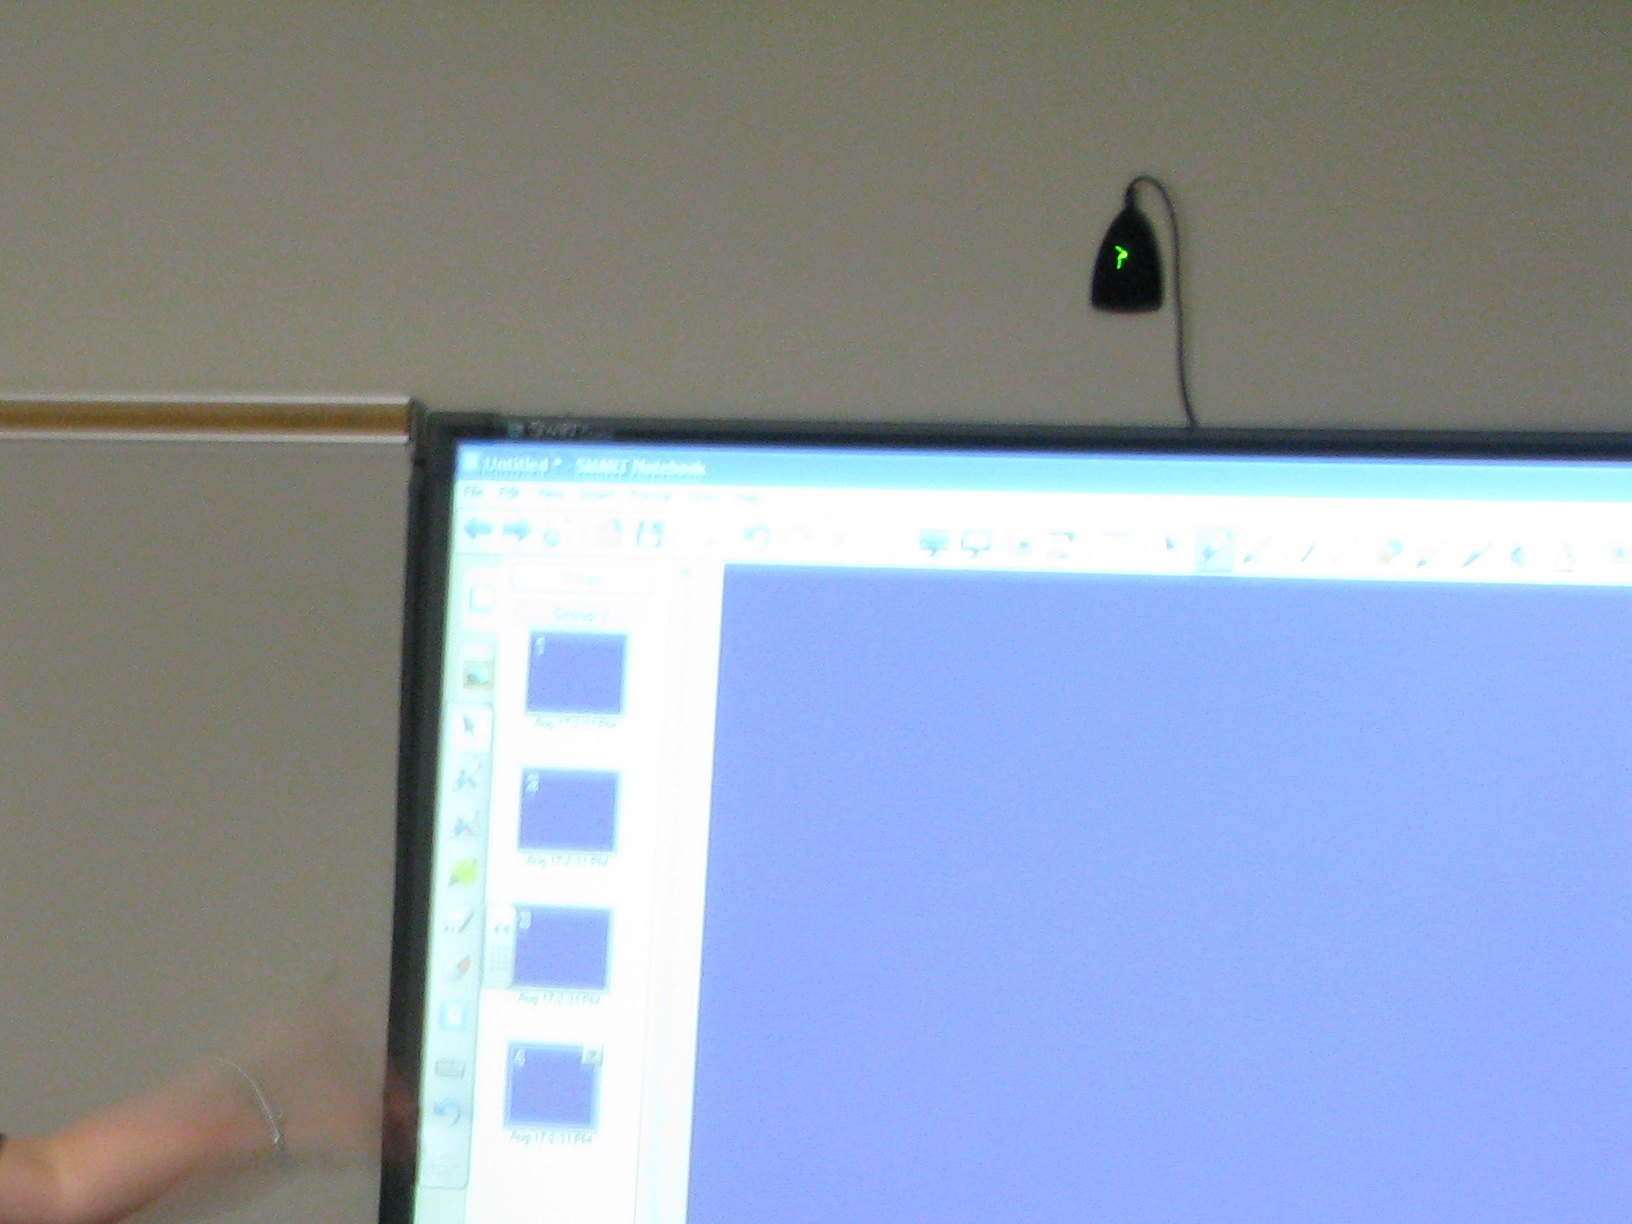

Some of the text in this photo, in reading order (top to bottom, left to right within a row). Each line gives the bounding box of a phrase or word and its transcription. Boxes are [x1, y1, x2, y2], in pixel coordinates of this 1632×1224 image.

[484, 455, 548, 475] Untitled
[575, 458, 627, 475] SMART
[631, 459, 707, 477] Notebook
